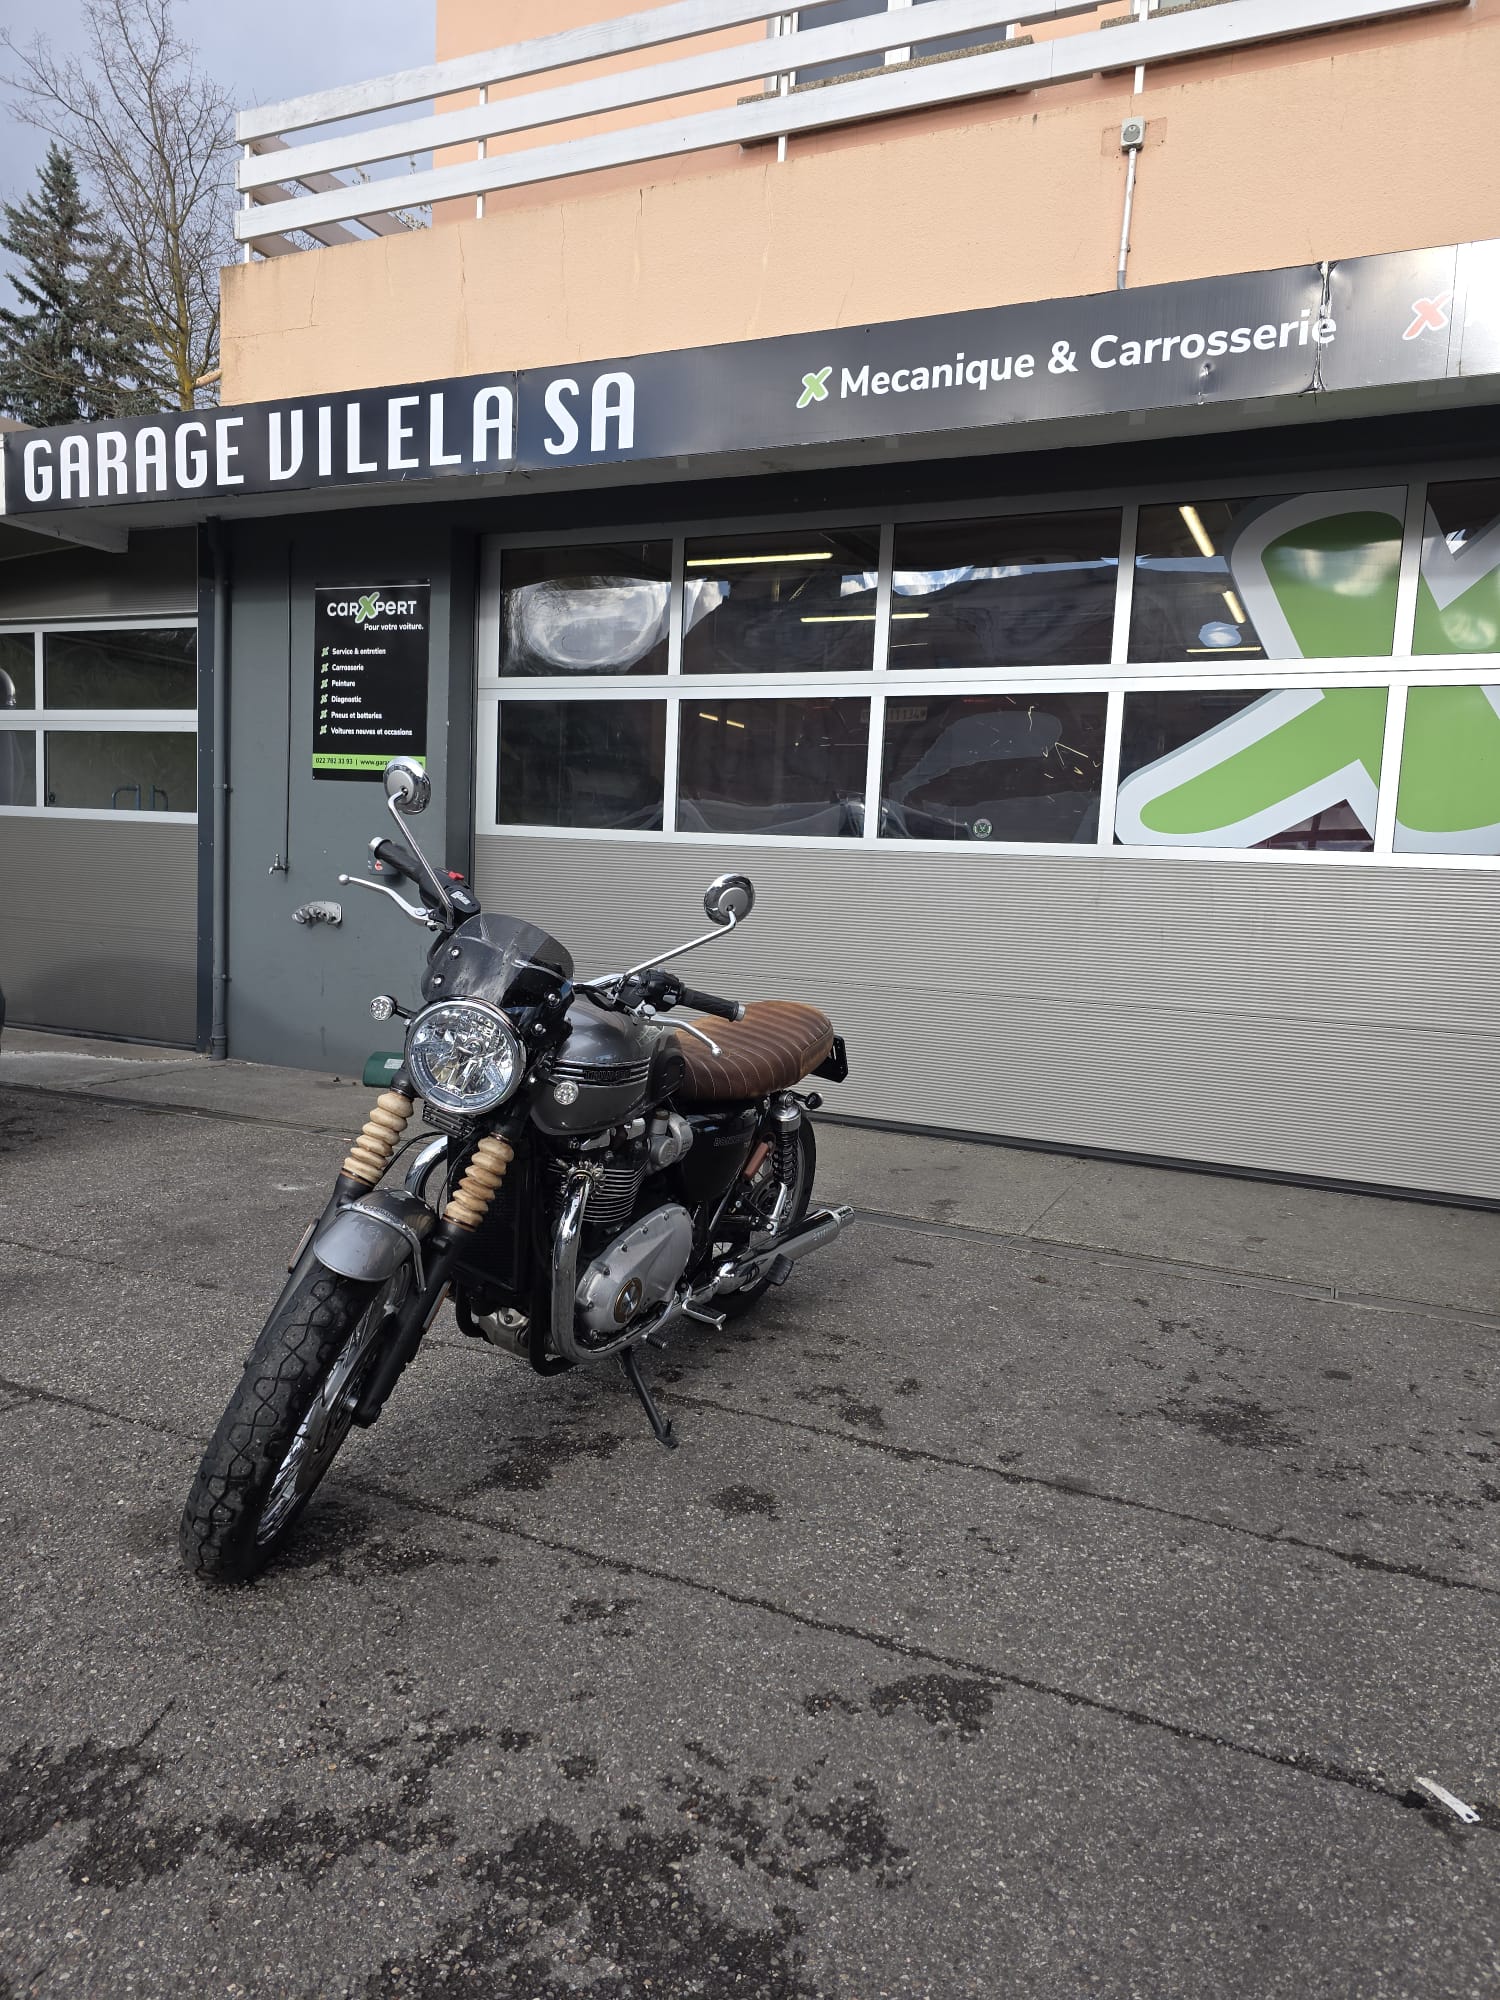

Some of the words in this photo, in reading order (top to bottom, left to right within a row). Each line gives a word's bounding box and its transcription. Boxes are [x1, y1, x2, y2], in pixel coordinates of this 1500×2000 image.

[840, 353, 1034, 399] Mecanique
[1047, 340, 1077, 374] &
[1091, 309, 1338, 368] Carrosserie
[24, 416, 244, 503] GARAGE
[269, 386, 514, 481] VILELA
[544, 371, 635, 456] SA
[364, 623, 379, 631] Pour
[381, 623, 398, 631] votre
[399, 622, 424, 631] voiture.
[332, 647, 353, 655] Service
[360, 647, 387, 655] entretien
[331, 663, 364, 671] Carrosserie
[331, 695, 362, 704] Diagnostic
[331, 711, 349, 719] Pneus
[349, 711, 356, 719] et
[356, 711, 383, 719] batteries
[330, 727, 354, 735] Voitures
[383, 728, 413, 736] occasions
